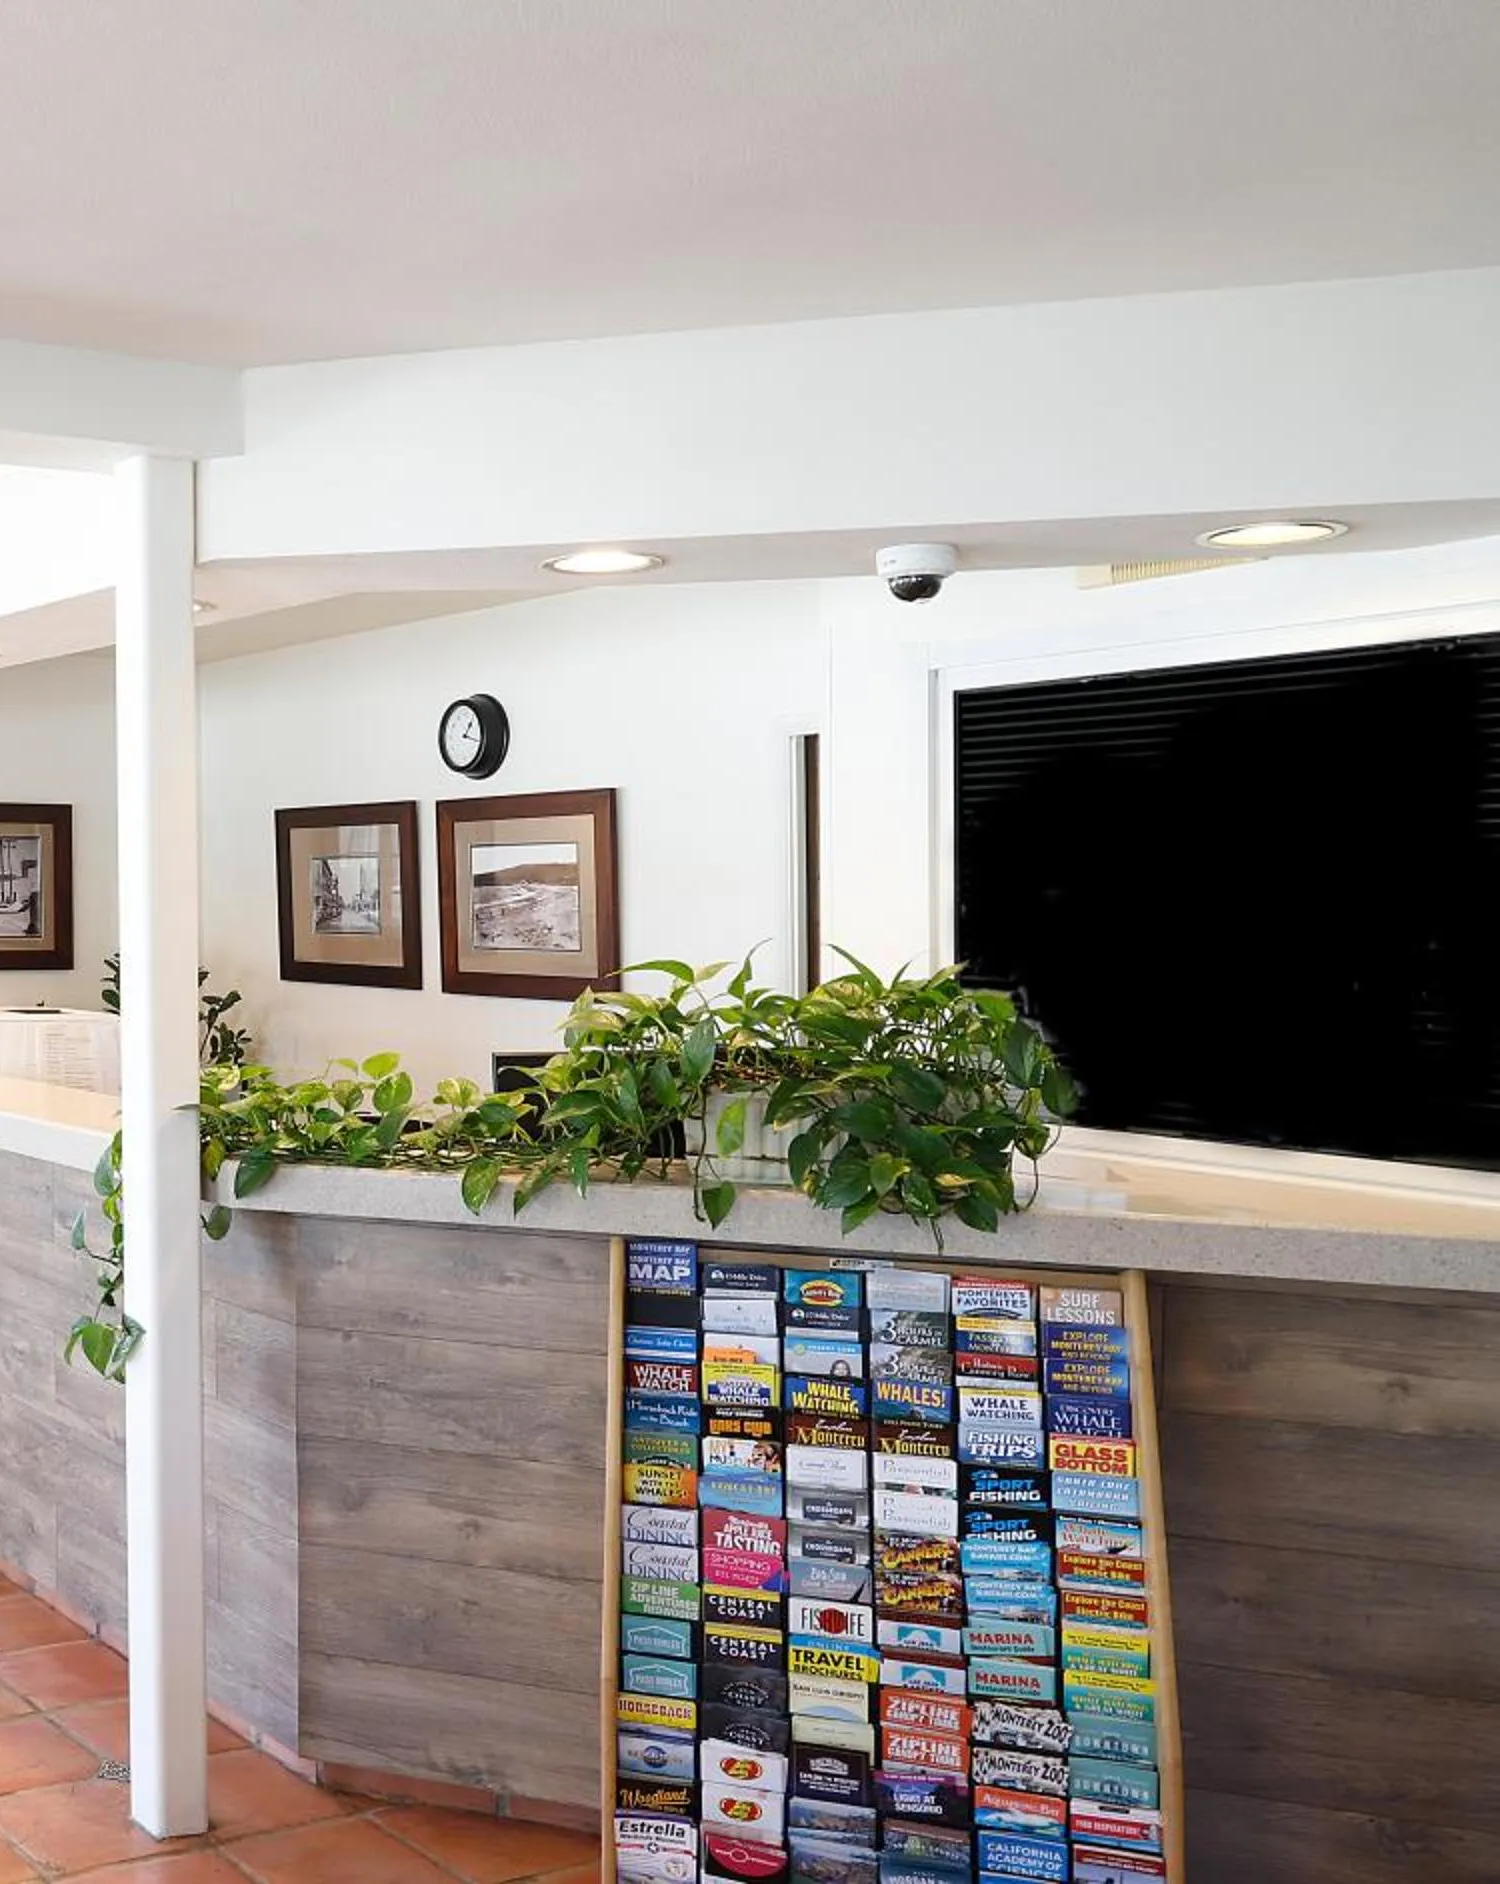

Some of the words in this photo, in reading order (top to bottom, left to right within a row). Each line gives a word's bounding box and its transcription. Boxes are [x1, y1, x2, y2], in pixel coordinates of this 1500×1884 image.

[628, 1264, 691, 1281] MAP
[957, 1289, 1027, 1299] MONTEREY'S
[1061, 1290, 1101, 1309] SURF
[957, 1297, 1029, 1309] FAVORITES
[1047, 1307, 1116, 1326] LESSONS
[881, 1317, 897, 1342] 3
[1063, 1331, 1109, 1343] EXPLORE
[1051, 1341, 1100, 1352] MONTEREY
[883, 1351, 899, 1375] 3
[1063, 1363, 1111, 1375] EXPLORE
[633, 1365, 693, 1381] WHALE
[1052, 1372, 1102, 1384] MONTEREY
[638, 1377, 689, 1392] WATCH
[719, 1386, 760, 1397] WHALE
[807, 1382, 851, 1400] WHALE
[792, 1392, 860, 1414] WATCHING
[877, 1381, 946, 1408] WHALES!
[971, 1397, 1029, 1410] WHALE
[965, 1409, 1035, 1421] WATCHING
[1055, 1411, 1122, 1430] WHALE
[796, 1426, 865, 1448] Monterey
[967, 1431, 1036, 1447] FISHING
[879, 1437, 950, 1457] Monterey
[968, 1443, 1037, 1459] TRIPS
[1055, 1443, 1128, 1462] GLASS
[1055, 1457, 1129, 1475] BOTTOM
[975, 1479, 1036, 1491] SPORT
[969, 1489, 1041, 1502] FISHING
[627, 1508, 691, 1530] Coastal
[971, 1519, 1030, 1532] SPORT
[627, 1527, 693, 1545] DINING
[713, 1531, 781, 1556] TASTING
[965, 1529, 1038, 1542] FISHING
[629, 1546, 693, 1568] Coastal
[1063, 1553, 1098, 1567] Explore
[629, 1564, 696, 1582] DINING
[652, 1583, 680, 1597] LINE
[709, 1595, 774, 1612] CENTRAL
[1065, 1593, 1099, 1607] Explore
[717, 1606, 765, 1620] COAST
[709, 1636, 777, 1653] CENTRAL
[968, 1632, 1035, 1645] MARINA
[719, 1647, 767, 1661] COAST
[793, 1649, 865, 1671] TRAVEL
[793, 1664, 863, 1681] BROCHURES
[975, 1671, 1041, 1689] MARINA
[618, 1699, 693, 1720] HORSEBACK
[888, 1695, 960, 1721] ZIPLINE
[991, 1708, 1044, 1732] MONTEREY
[1043, 1718, 1070, 1743] ZOO
[889, 1731, 962, 1756] ZIPLINE
[988, 1754, 1040, 1776] MONTEREY
[1041, 1763, 1066, 1785] ZOO
[619, 1820, 686, 1838] Estrella
[987, 1843, 1063, 1862] CALIFORNIA
[987, 1853, 1045, 1868] ACADEMY
[1048, 1862, 1063, 1872] OF
